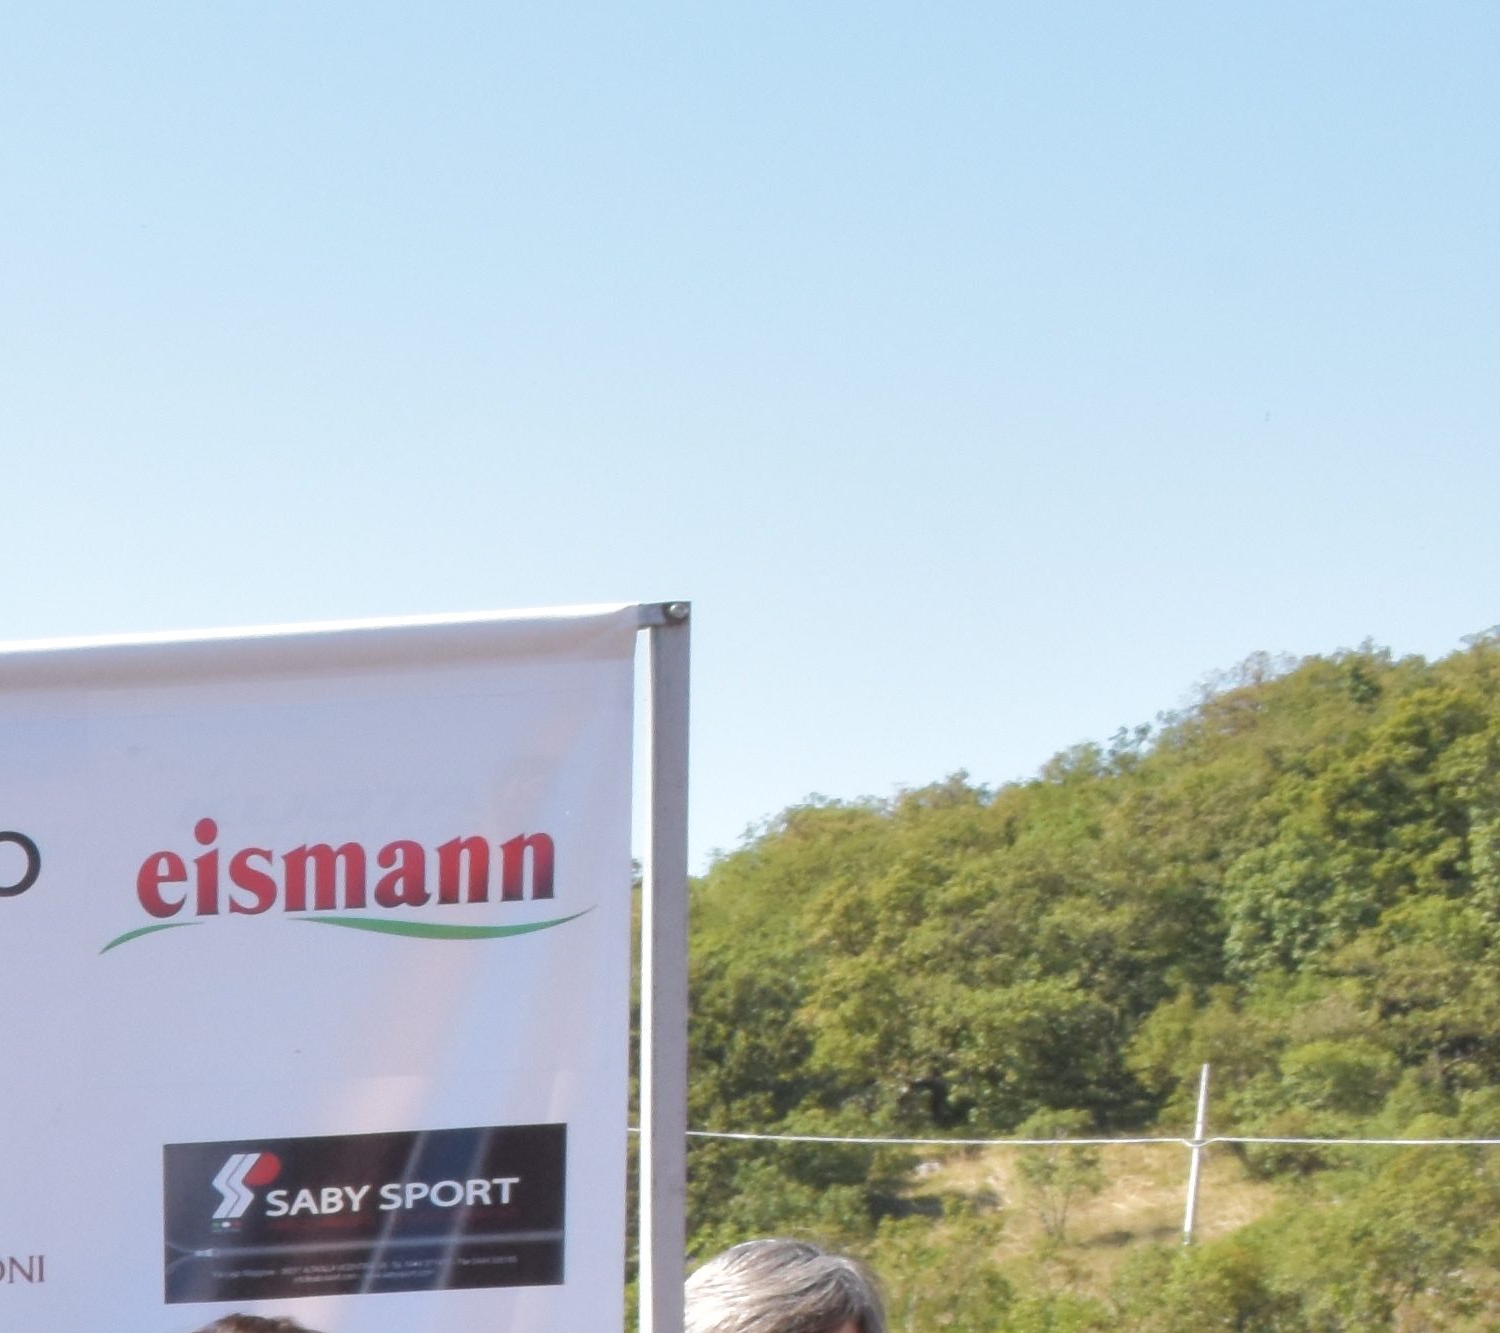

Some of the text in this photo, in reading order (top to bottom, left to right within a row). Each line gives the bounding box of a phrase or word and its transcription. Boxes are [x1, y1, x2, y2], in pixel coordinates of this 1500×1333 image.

[136, 817, 557, 918] eismann
[266, 1177, 520, 1217] SABY SPORT
